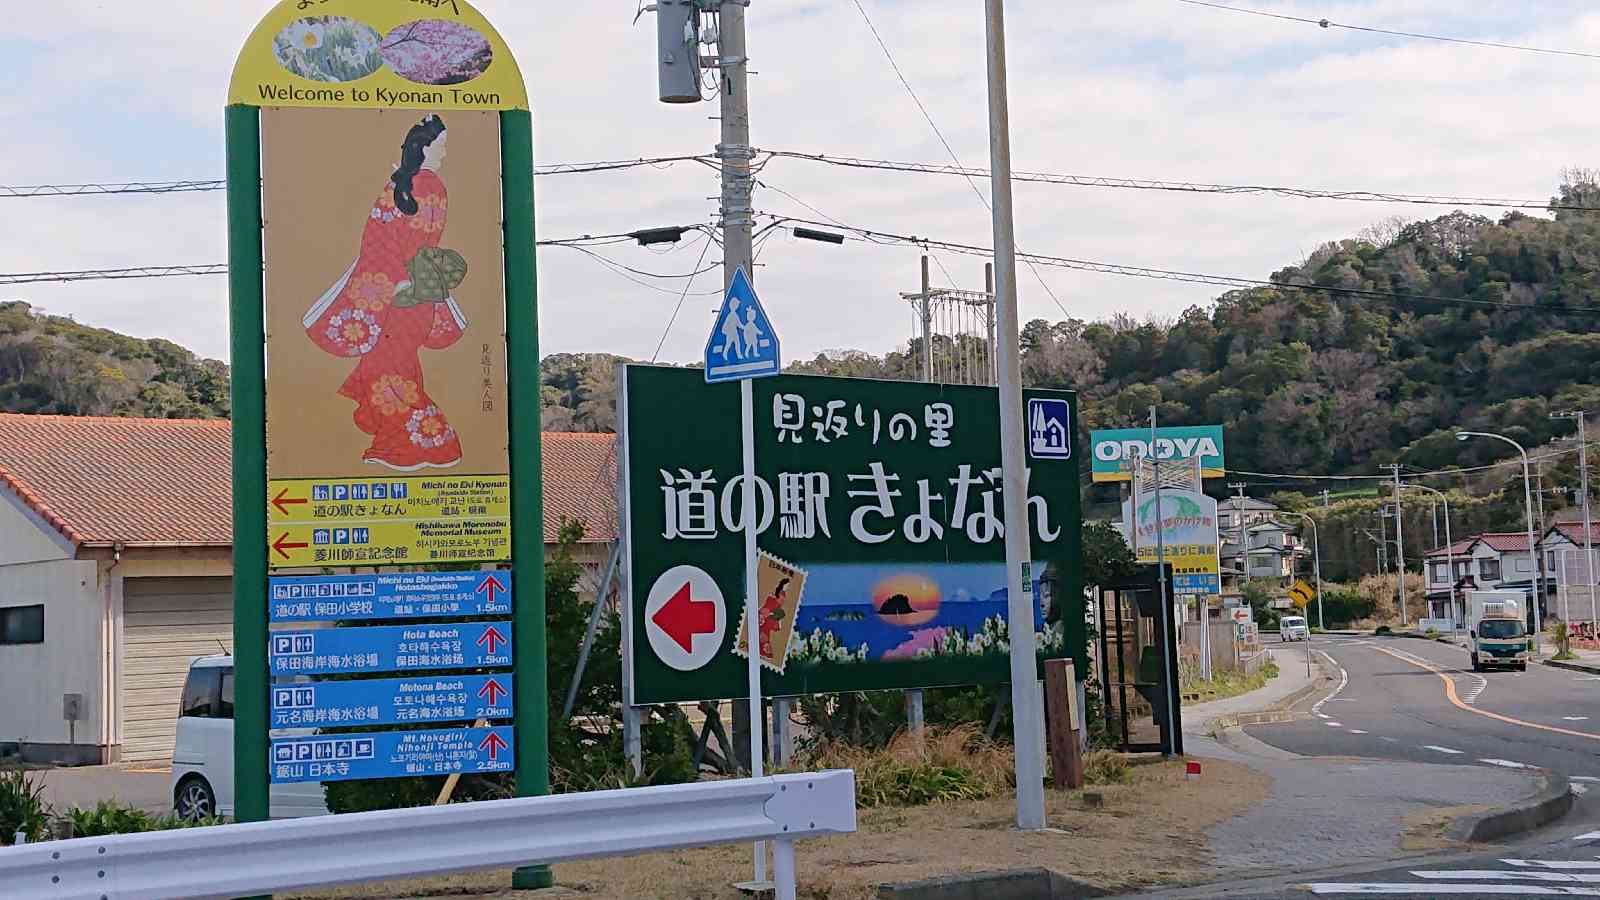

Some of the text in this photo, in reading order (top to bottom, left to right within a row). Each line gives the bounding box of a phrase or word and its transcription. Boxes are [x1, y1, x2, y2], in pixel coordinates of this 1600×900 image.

[258, 84, 500, 106] Welcome to Kyonan Town
[772, 393, 954, 448] 見返りの里
[1094, 436, 1220, 461] ODOYA
[421, 481, 446, 489] Michi
[460, 480, 474, 489] Eki
[475, 480, 508, 490] Kyonan
[275, 601, 373, 617] 道の駅 保田小学校
[476, 603, 508, 613] 1.5km
[402, 628, 459, 640] Hota Beach
[276, 653, 379, 671] 保田海岸海水浴場
[477, 654, 509, 665] 1.5km
[399, 680, 464, 692] Motona Beach
[275, 705, 379, 724] 元名海岸海水浴場
[476, 707, 510, 717] 2.0km
[397, 741, 473, 753] Nihonji Temple
[276, 762, 350, 779] 鋸山 日本寺
[476, 760, 510, 770] 2.5km
